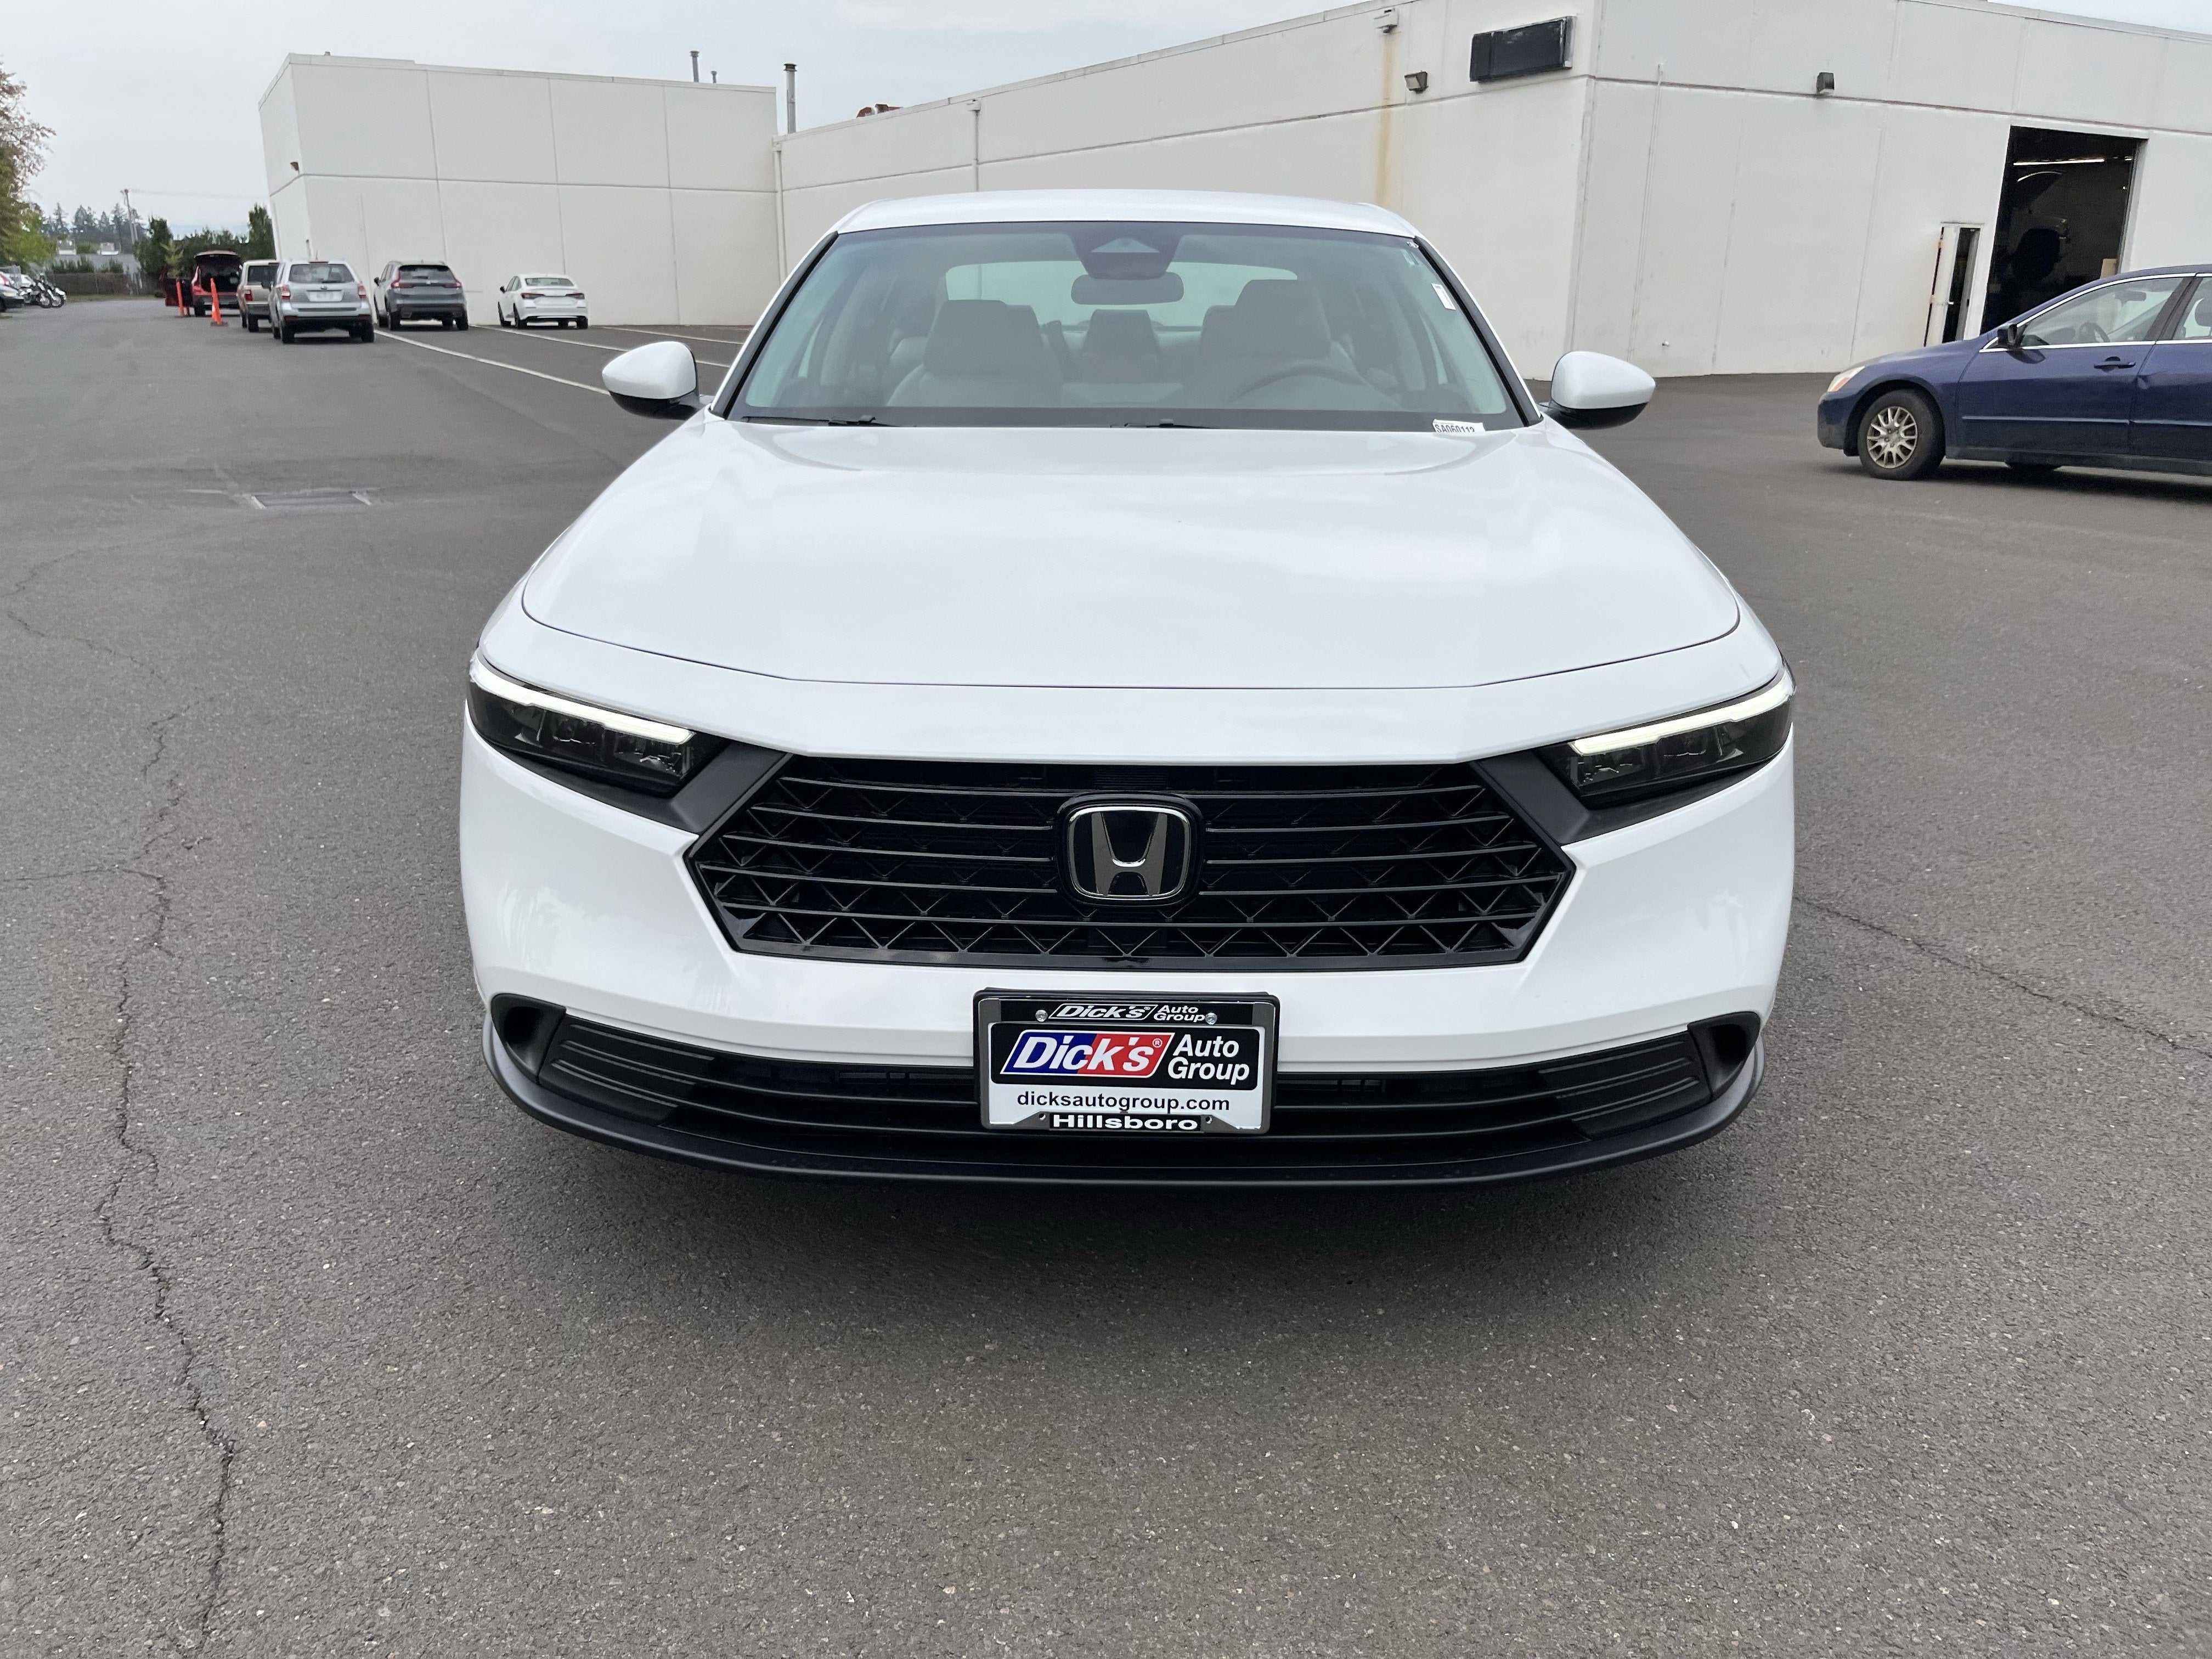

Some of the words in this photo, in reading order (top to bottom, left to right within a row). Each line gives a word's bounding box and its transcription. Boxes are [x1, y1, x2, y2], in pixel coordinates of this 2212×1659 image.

[1153, 1013, 1205, 1022] Group
[1158, 1005, 1199, 1013] Auto
[1172, 1034, 1240, 1058] Auto
[1167, 1057, 1250, 1085] Group
[1017, 1091, 1230, 1114] dicksautogroup.com
[1053, 1114, 1198, 1130] Hillsboro
